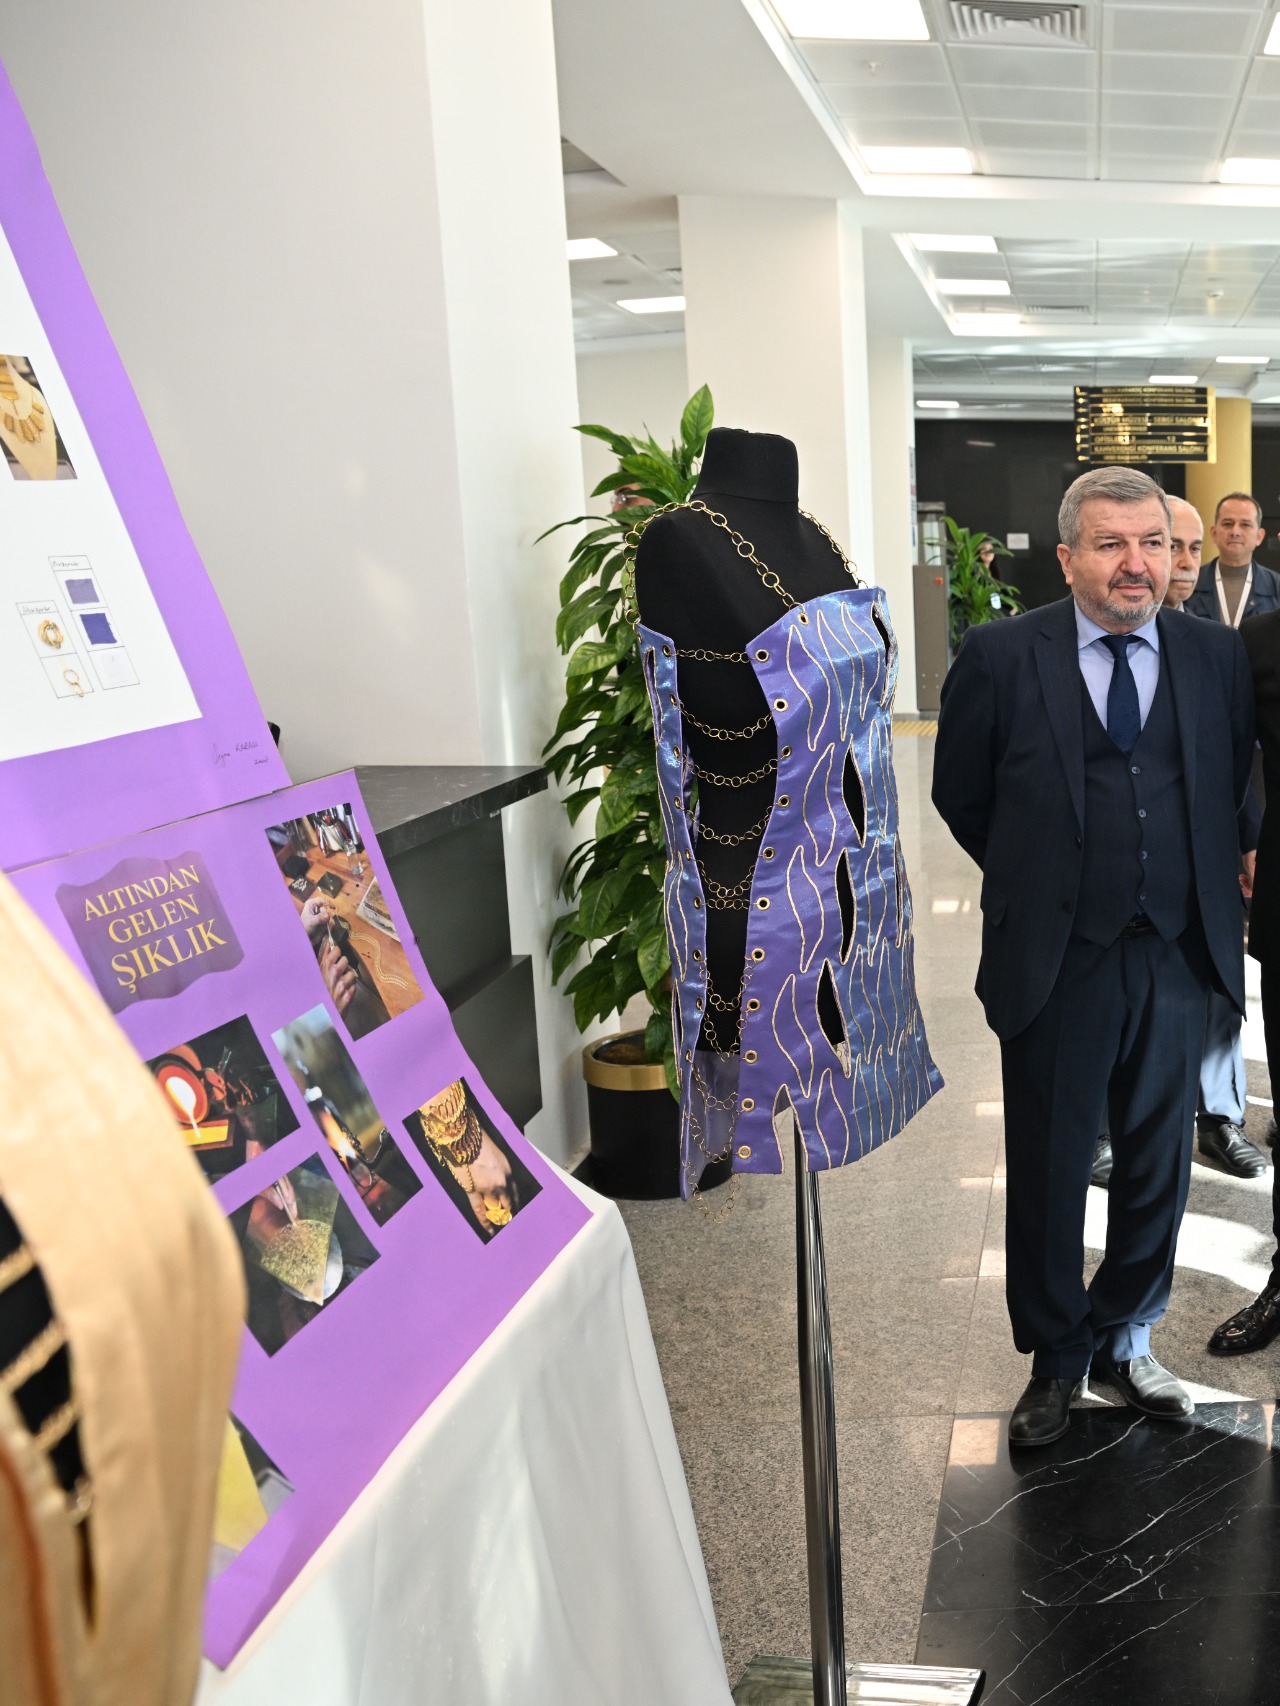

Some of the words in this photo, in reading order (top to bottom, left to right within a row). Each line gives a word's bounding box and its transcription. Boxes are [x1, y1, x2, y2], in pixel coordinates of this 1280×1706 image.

[85, 864, 200, 921] ALTINDAN
[108, 893, 200, 944] GELEN
[111, 918, 227, 994] ŞIKLIK
